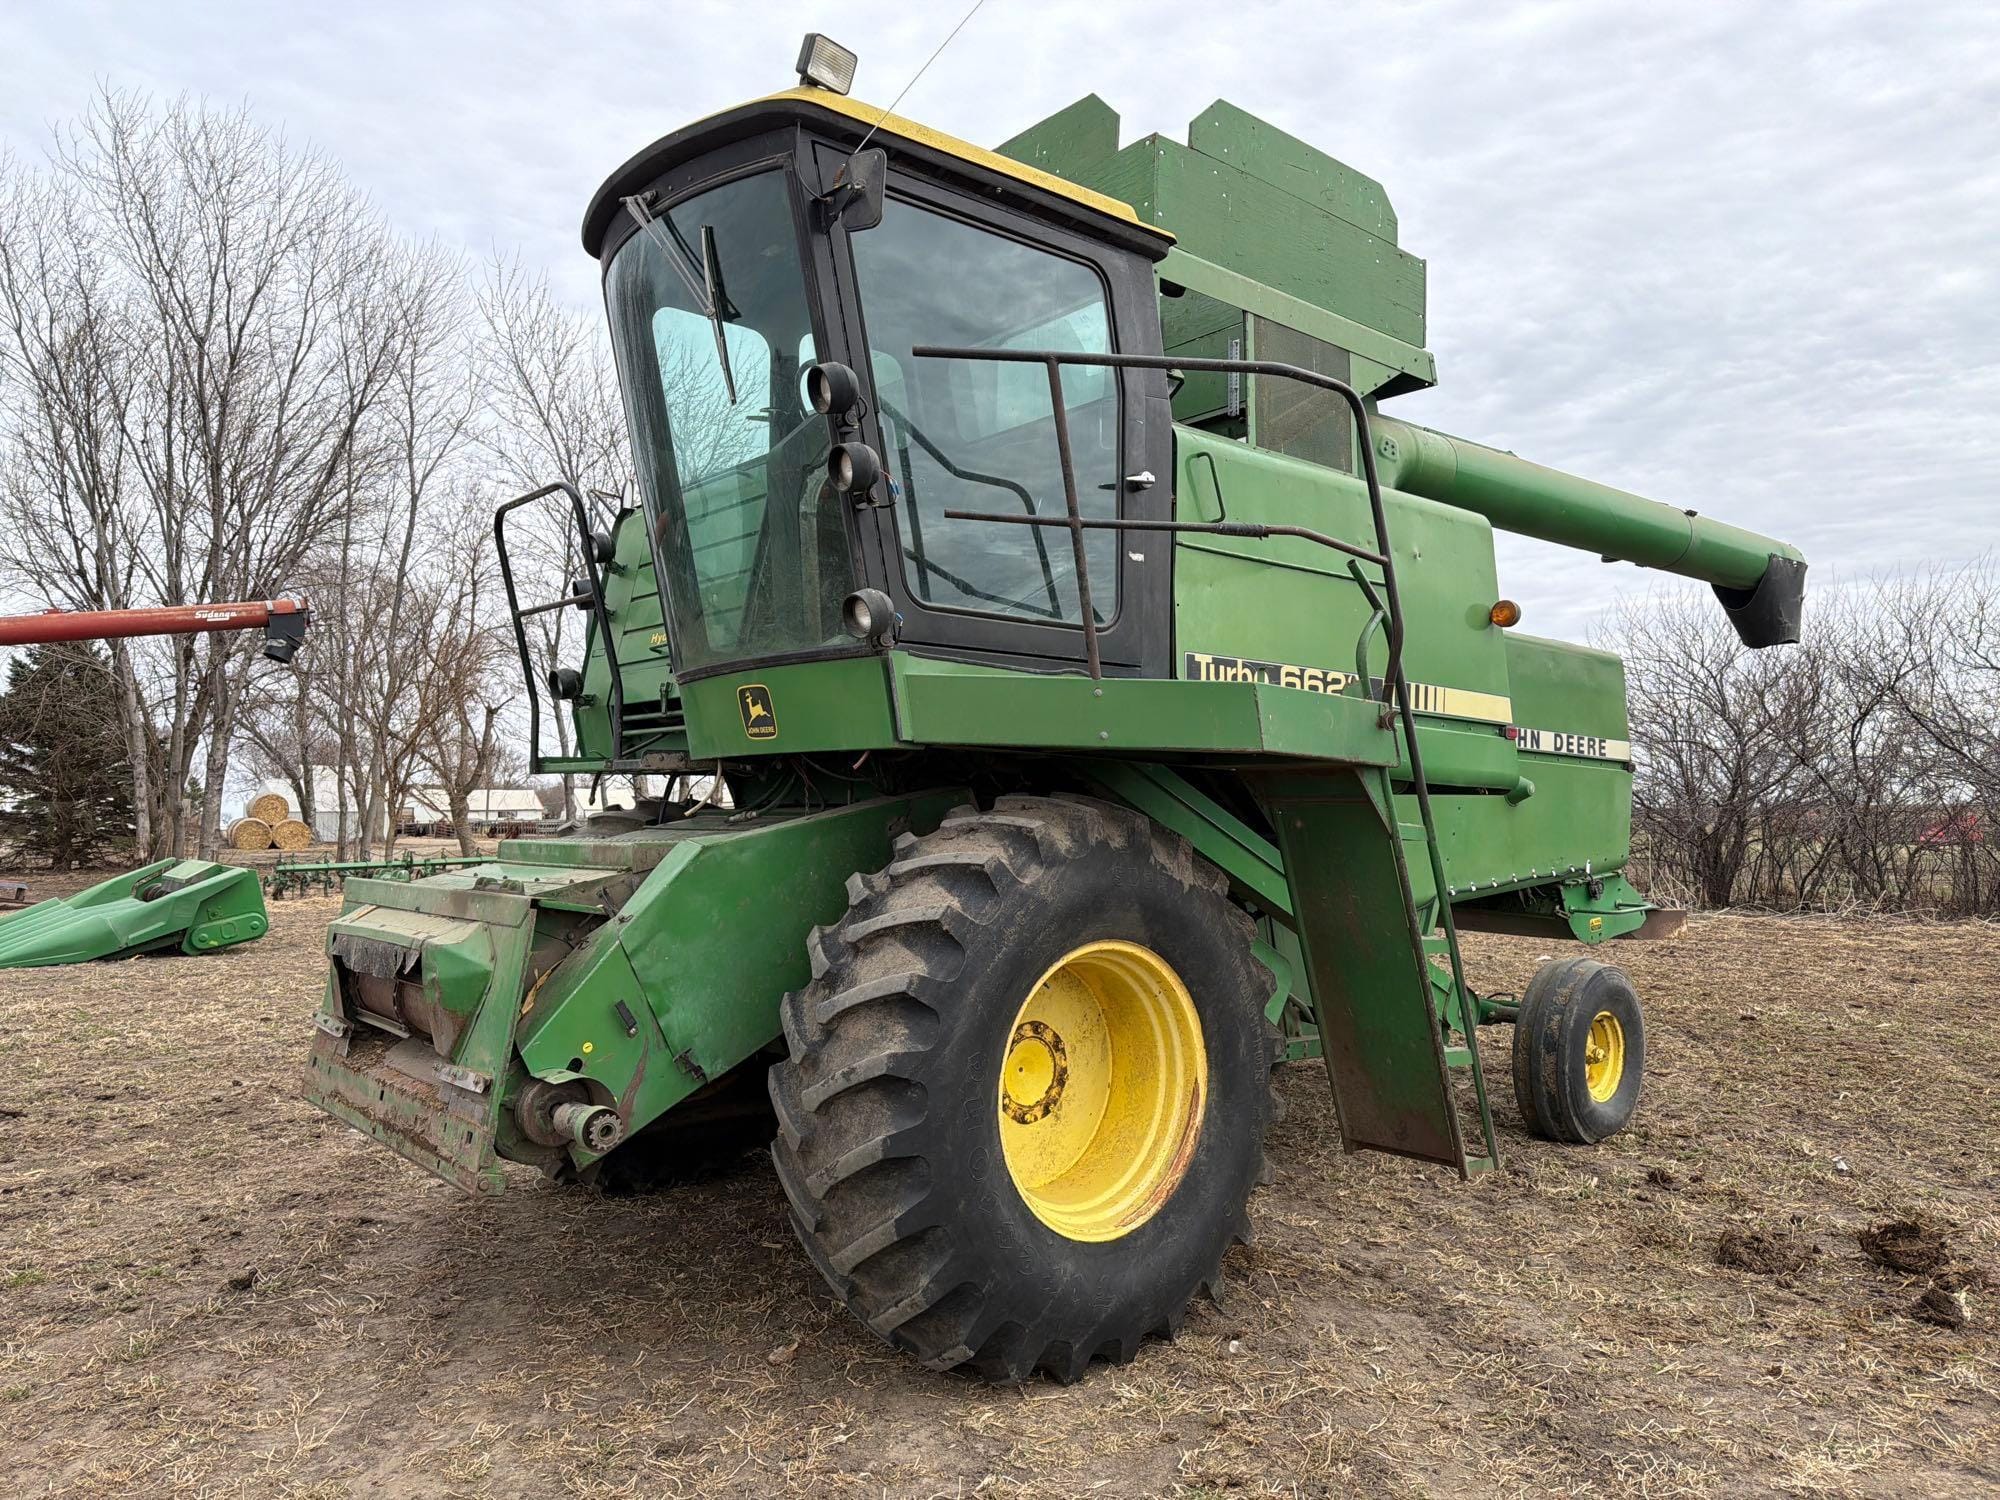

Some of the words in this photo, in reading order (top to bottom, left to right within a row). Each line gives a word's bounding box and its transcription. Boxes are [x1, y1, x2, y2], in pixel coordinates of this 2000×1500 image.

[195, 610, 237, 620] Sudenga
[1280, 665, 1359, 696] 662
[1517, 727, 1541, 750] HN
[1553, 733, 1607, 757] DEERE
